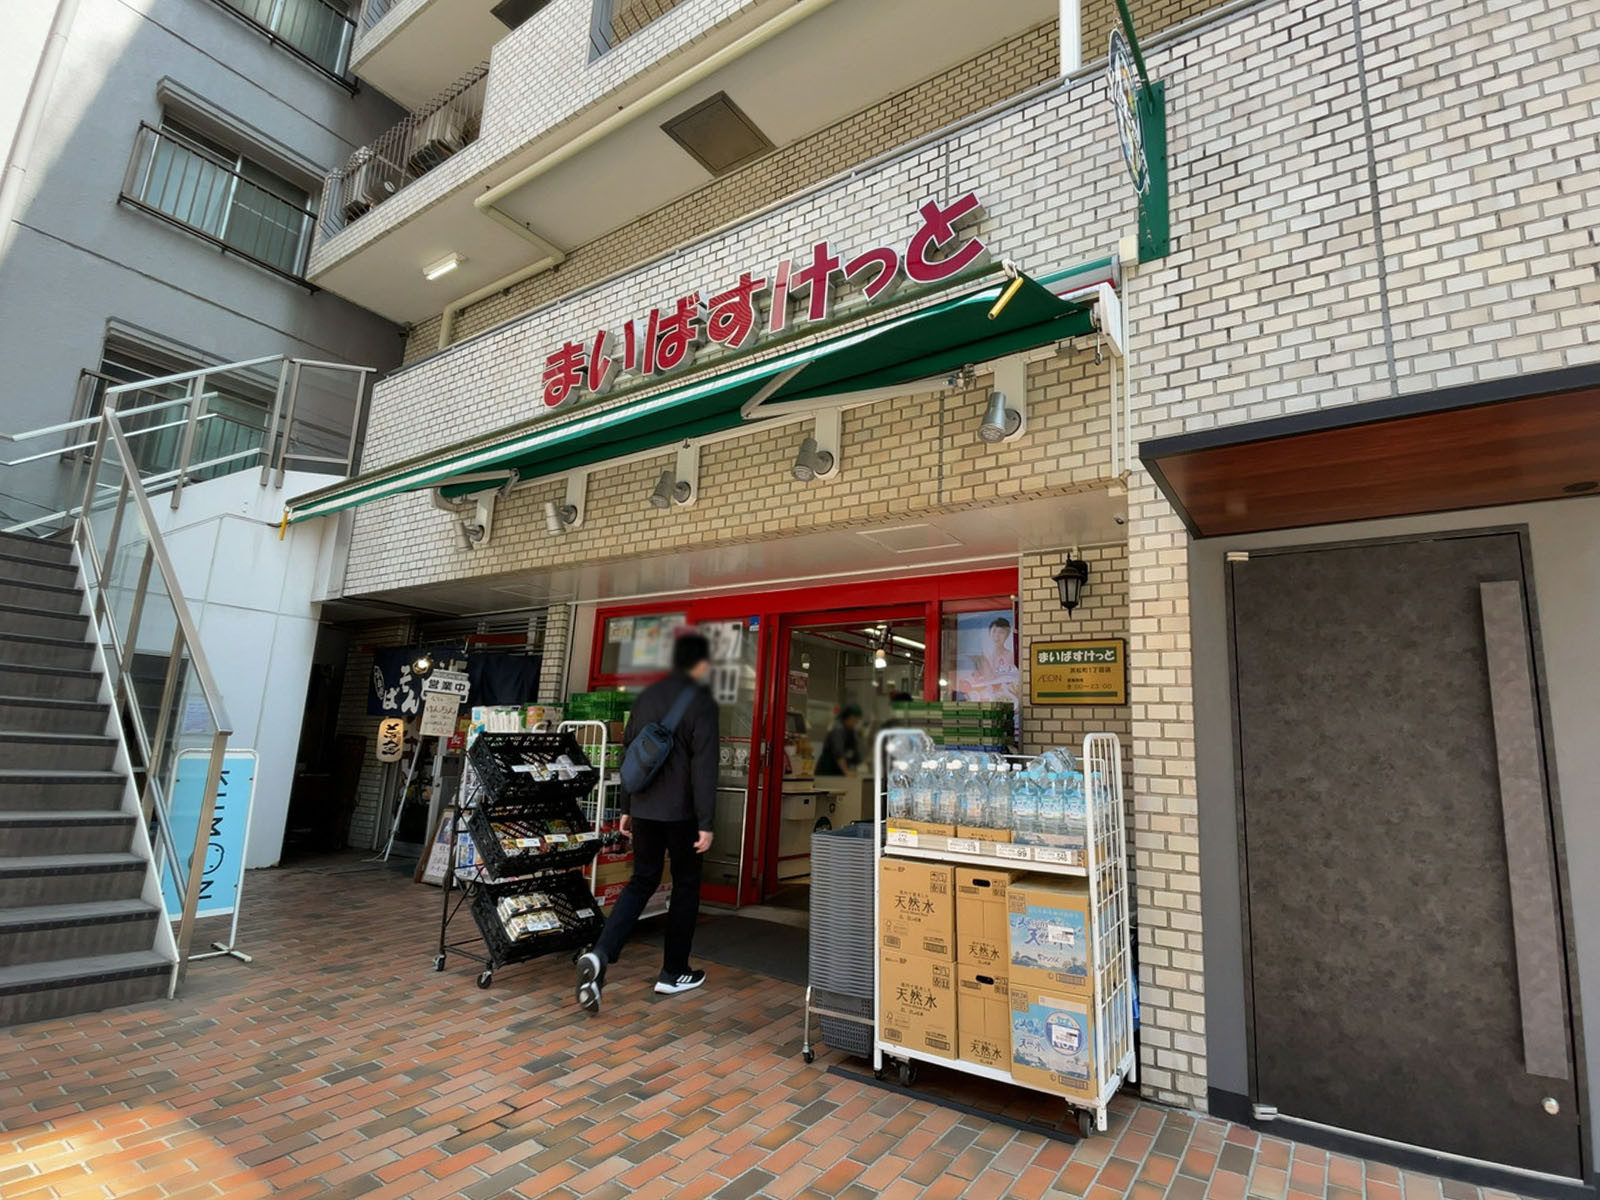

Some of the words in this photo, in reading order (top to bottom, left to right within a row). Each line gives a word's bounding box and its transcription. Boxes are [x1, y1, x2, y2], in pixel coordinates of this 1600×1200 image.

[543, 191, 987, 408] まいばすけっと
[1038, 649, 1115, 663] まいばすけっと
[428, 679, 466, 692] 営業中
[895, 894, 935, 914] 天然水
[968, 943, 1000, 960] 天然水
[896, 986, 938, 1009] 天然水
[970, 1040, 1002, 1060] 天然水
